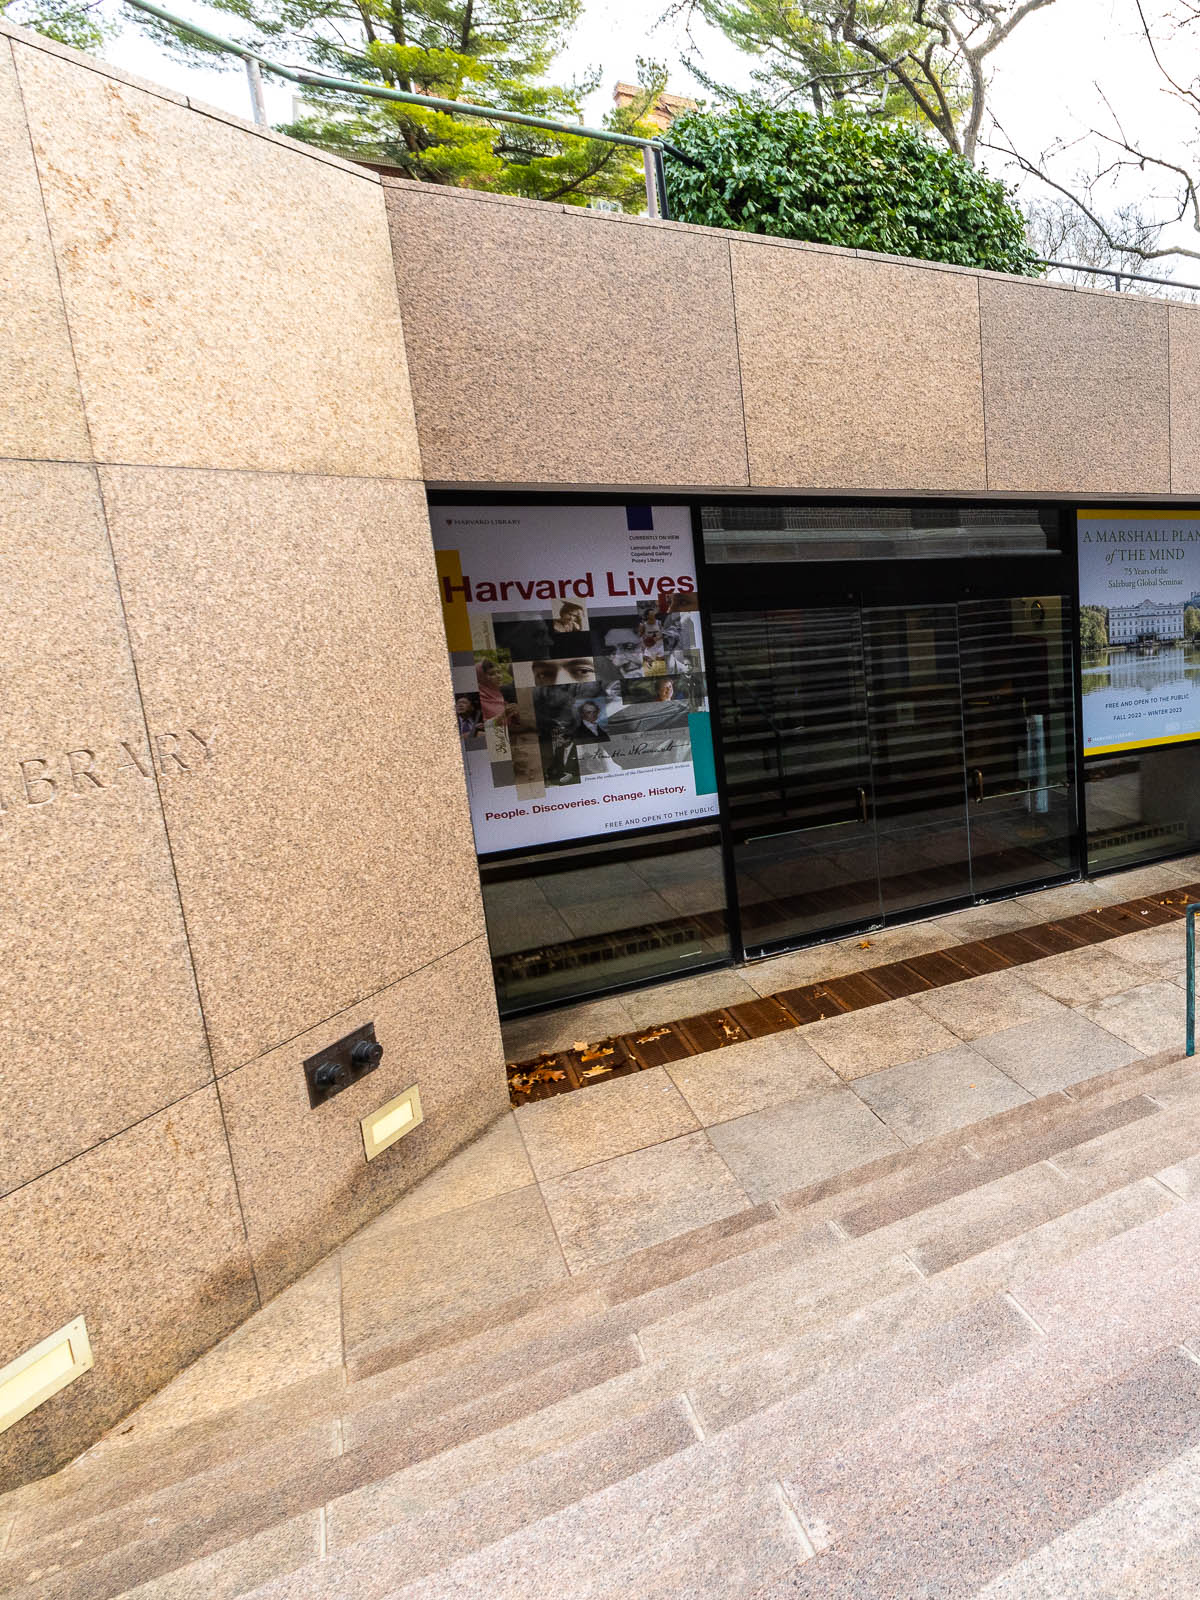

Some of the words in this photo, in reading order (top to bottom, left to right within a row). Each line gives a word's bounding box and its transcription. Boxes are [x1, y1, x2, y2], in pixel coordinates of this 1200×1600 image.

[1083, 530, 1092, 542] A
[1096, 530, 1168, 542] MARSHALL
[1106, 548, 1118, 565] of
[1118, 549, 1146, 560] THE
[1150, 548, 1185, 560] MIND
[1158, 566, 1168, 574] the
[443, 572, 594, 603] Harvard
[606, 571, 696, 597] Lives
[1108, 579, 1136, 590] Salzburg
[1136, 578, 1158, 586] Global
[1158, 578, 1184, 586] Seminar
[1148, 708, 1168, 716] WINTER
[485, 808, 530, 821] People.
[532, 798, 600, 814] Discoveries.
[602, 791, 646, 804] Change.
[648, 784, 686, 796] History.
[604, 820, 624, 829] FREE
[624, 818, 640, 826] AND
[642, 815, 662, 823] OPEN
[690, 806, 715, 814] PUBLIC
